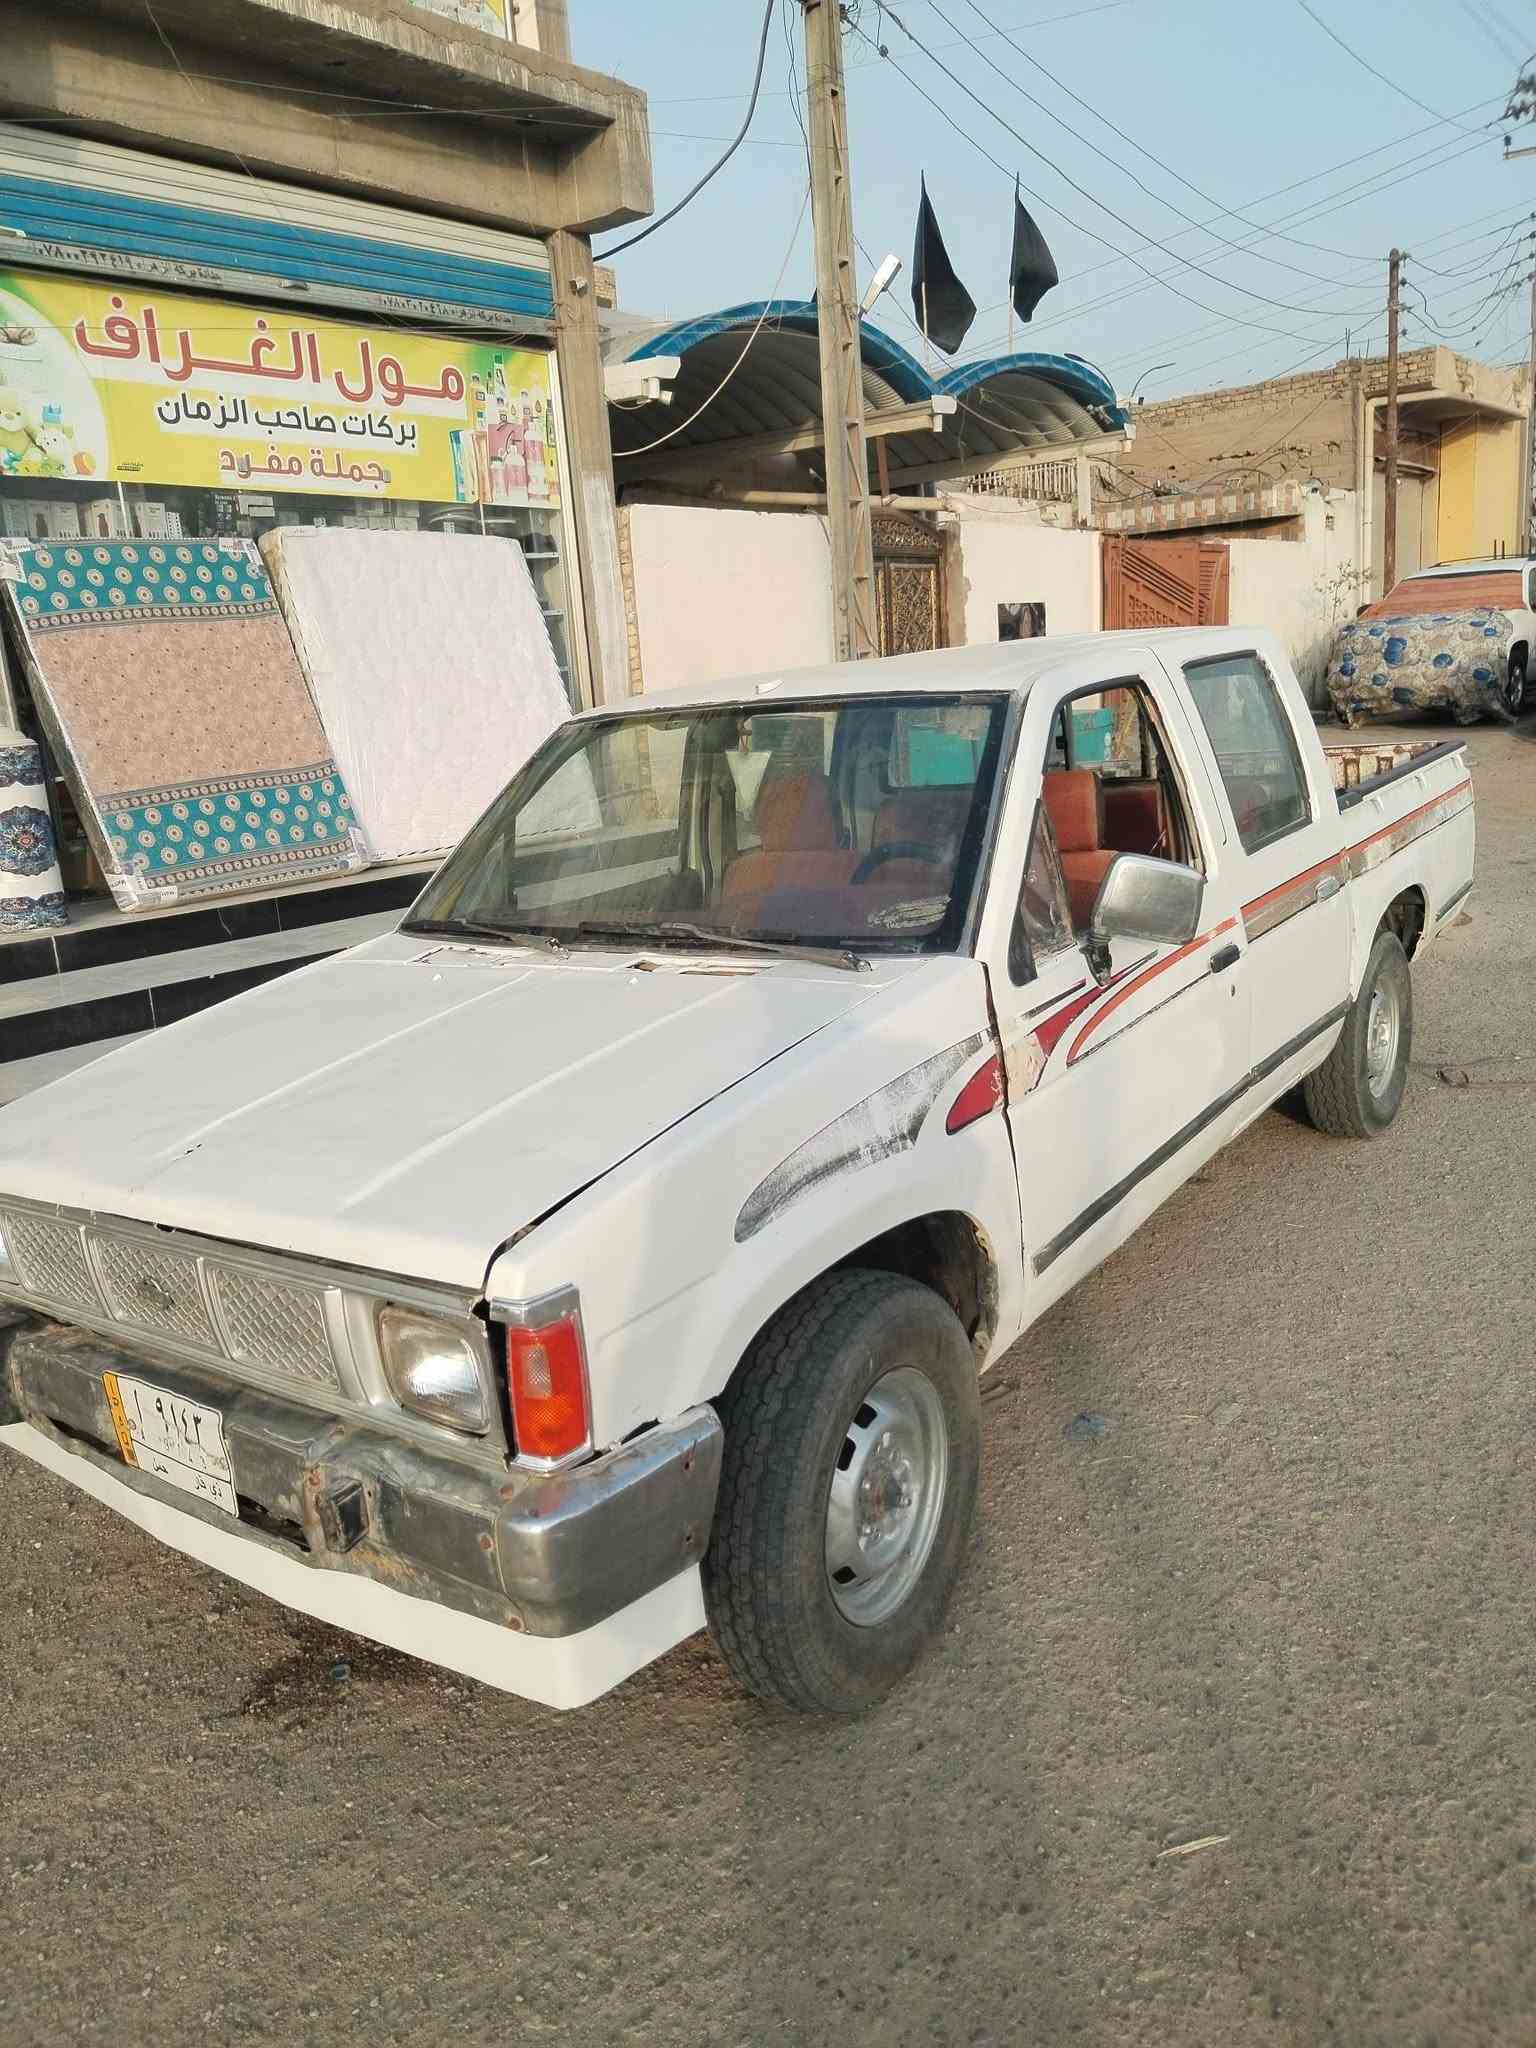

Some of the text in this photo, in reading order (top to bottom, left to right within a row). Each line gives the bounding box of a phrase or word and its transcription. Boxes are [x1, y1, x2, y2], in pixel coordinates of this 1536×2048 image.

[75, 296, 465, 407] مول الغراف
[157, 393, 417, 448] بركات صاحب الزمان
[220, 445, 386, 490] جملة مفرد
